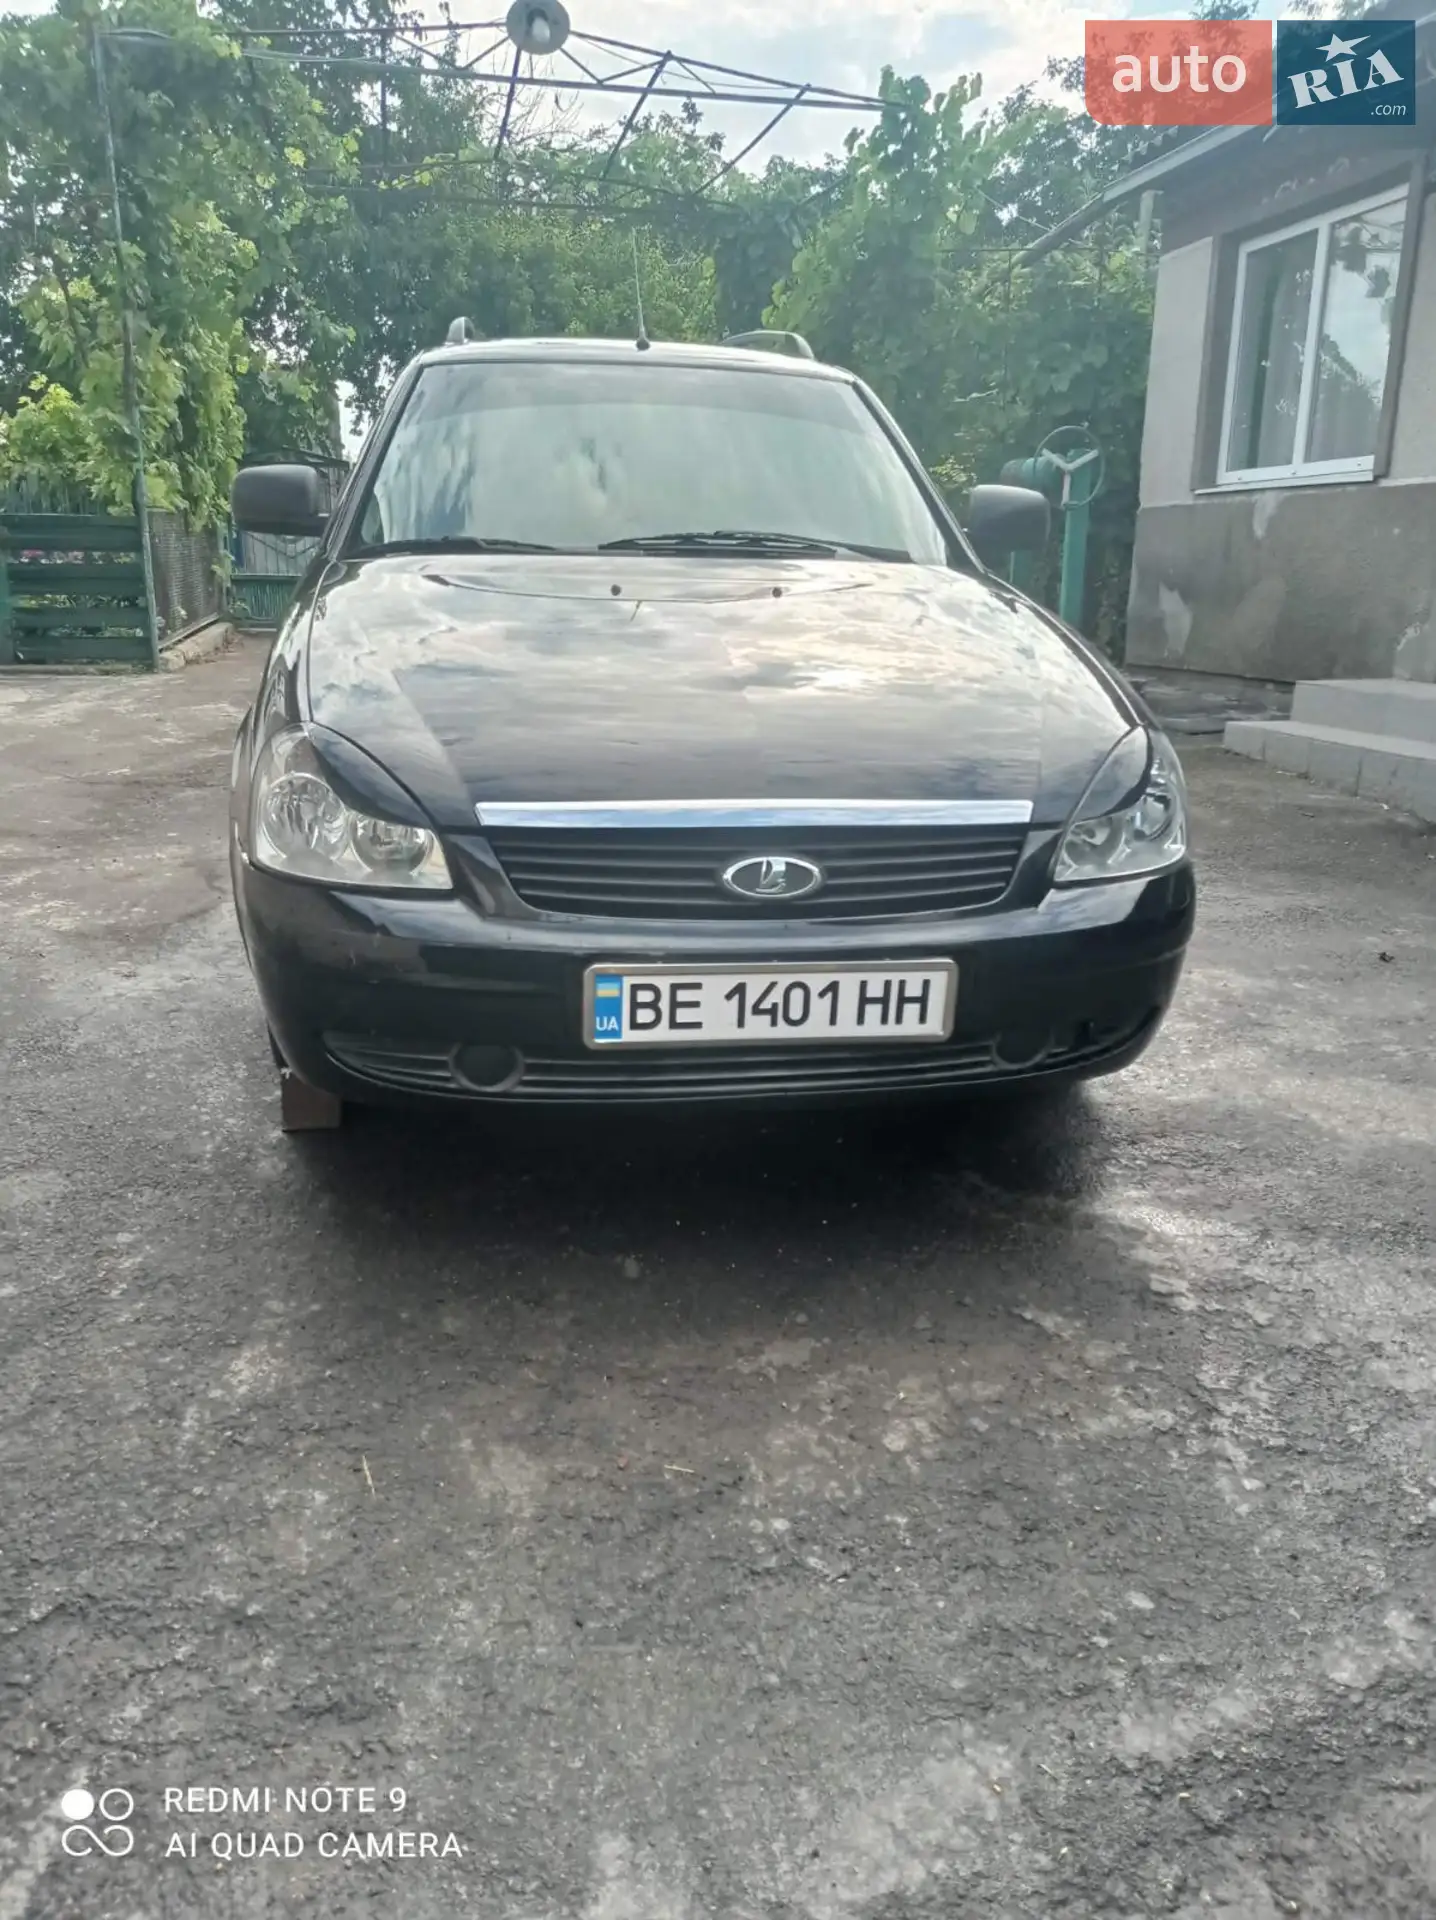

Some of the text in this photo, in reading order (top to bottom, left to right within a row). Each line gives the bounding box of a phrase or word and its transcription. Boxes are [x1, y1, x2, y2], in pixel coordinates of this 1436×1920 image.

[628, 979, 931, 1031] BE 1401 HH
[595, 1016, 619, 1031] UA
